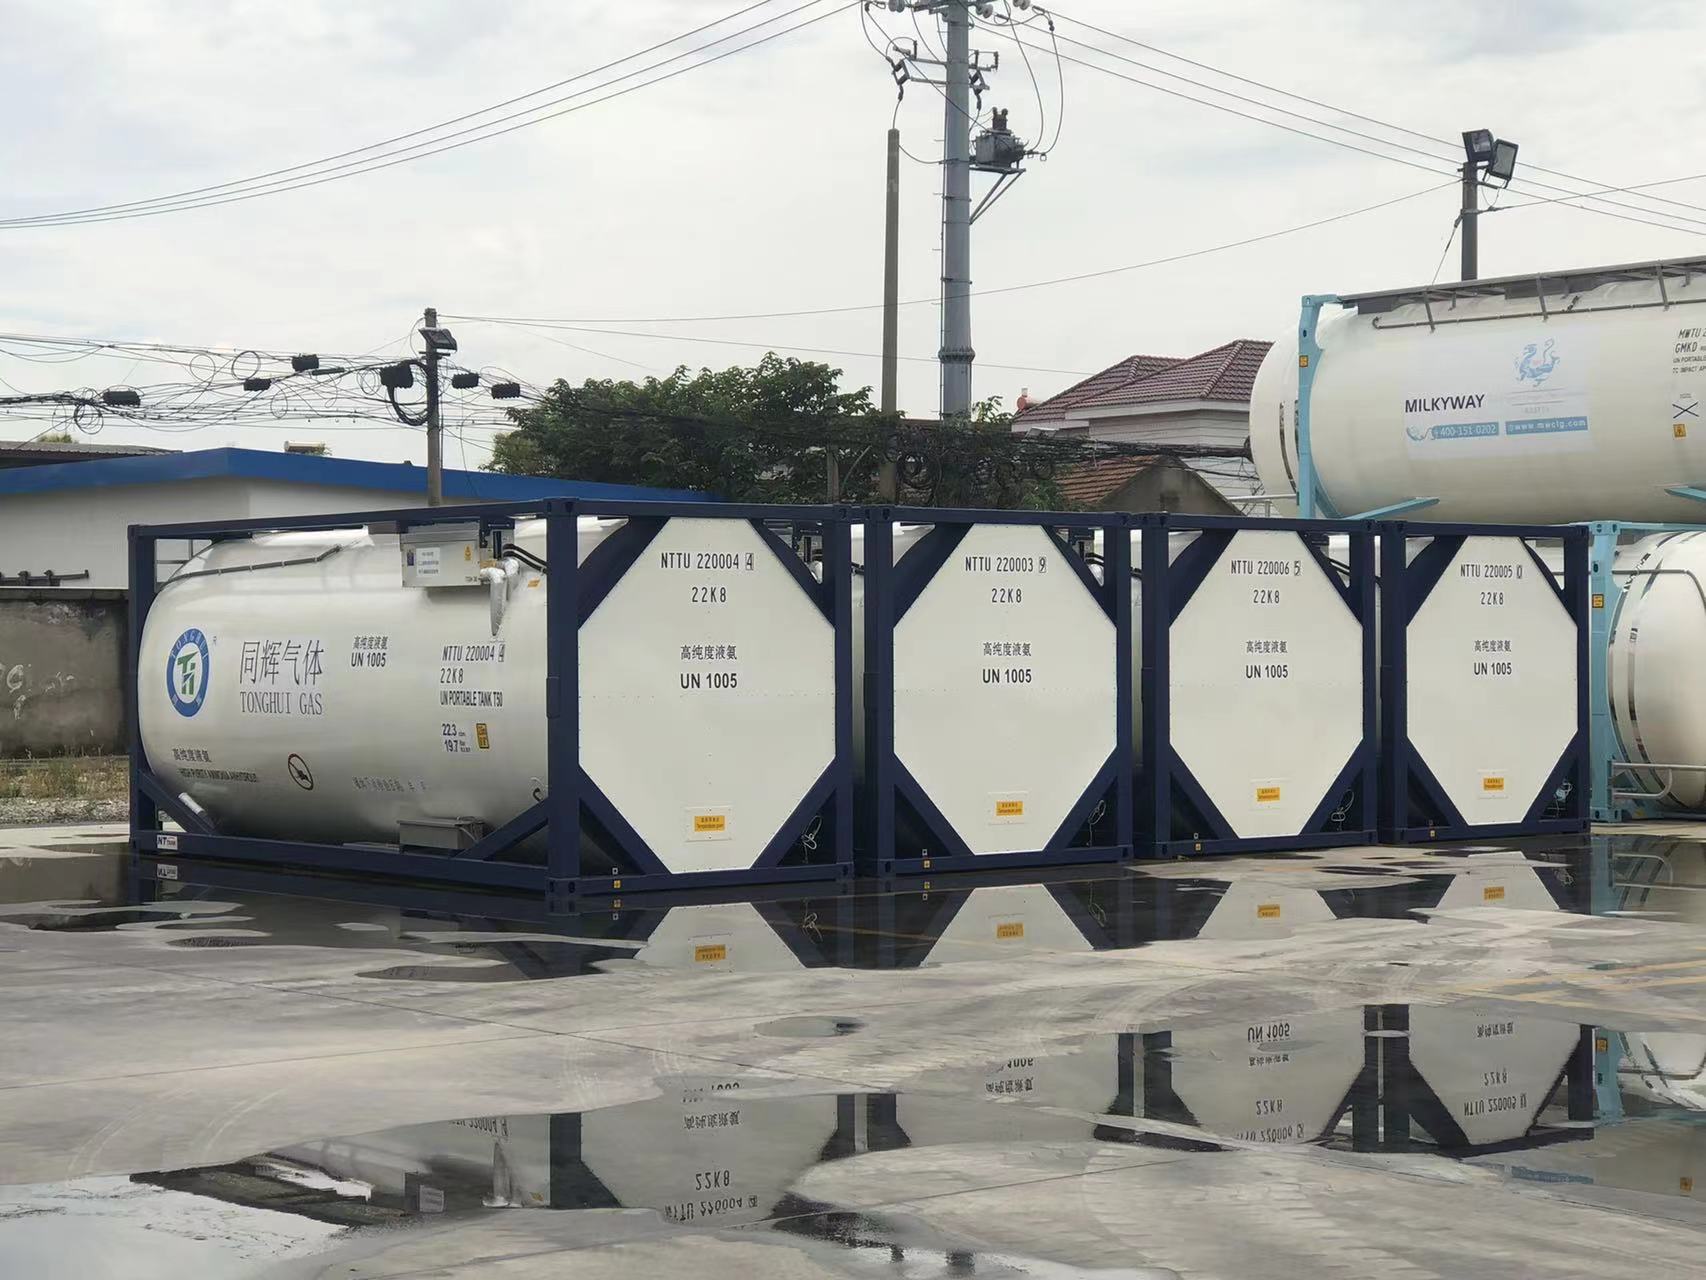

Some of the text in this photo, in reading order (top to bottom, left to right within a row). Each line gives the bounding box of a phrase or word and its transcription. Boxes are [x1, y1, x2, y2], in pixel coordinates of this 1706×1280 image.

[1678, 327, 1701, 339] MWTU
[1675, 342, 1698, 353] GMKD
[1405, 394, 1485, 413] MILKYWAY
[1440, 423, 1497, 436] 400-151-0202
[661, 553, 691, 569] NTTU
[697, 553, 739, 570] 220004
[965, 556, 991, 571] NTTU
[996, 557, 1034, 572] 220003
[1231, 560, 1253, 574] NTTU
[1257, 561, 1290, 575] 220006
[1460, 564, 1481, 577] NTTU
[1484, 565, 1513, 578] 220005
[691, 587, 727, 603] 22K8
[991, 588, 1022, 603] 22K8
[1253, 589, 1280, 603] 22K8
[1480, 592, 1504, 605] 22K8
[442, 645, 463, 661] NTTU
[465, 645, 495, 661] 220004
[680, 645, 737, 660] 高纯度液氨
[983, 642, 1032, 656] 高纯度液氨
[239, 639, 324, 686] 同辉气体
[351, 653, 386, 667] UN 1005
[440, 667, 464, 683] 22K8
[982, 669, 1032, 683] UN 1005
[1245, 665, 1288, 678] UN 1005
[1473, 663, 1512, 675] UN 1005
[680, 673, 738, 689] UN 1005
[240, 692, 323, 715] TONGHUI GAS
[440, 690, 449, 705] UN
[449, 690, 477, 706] PORTABLE
[478, 691, 492, 707] TANK
